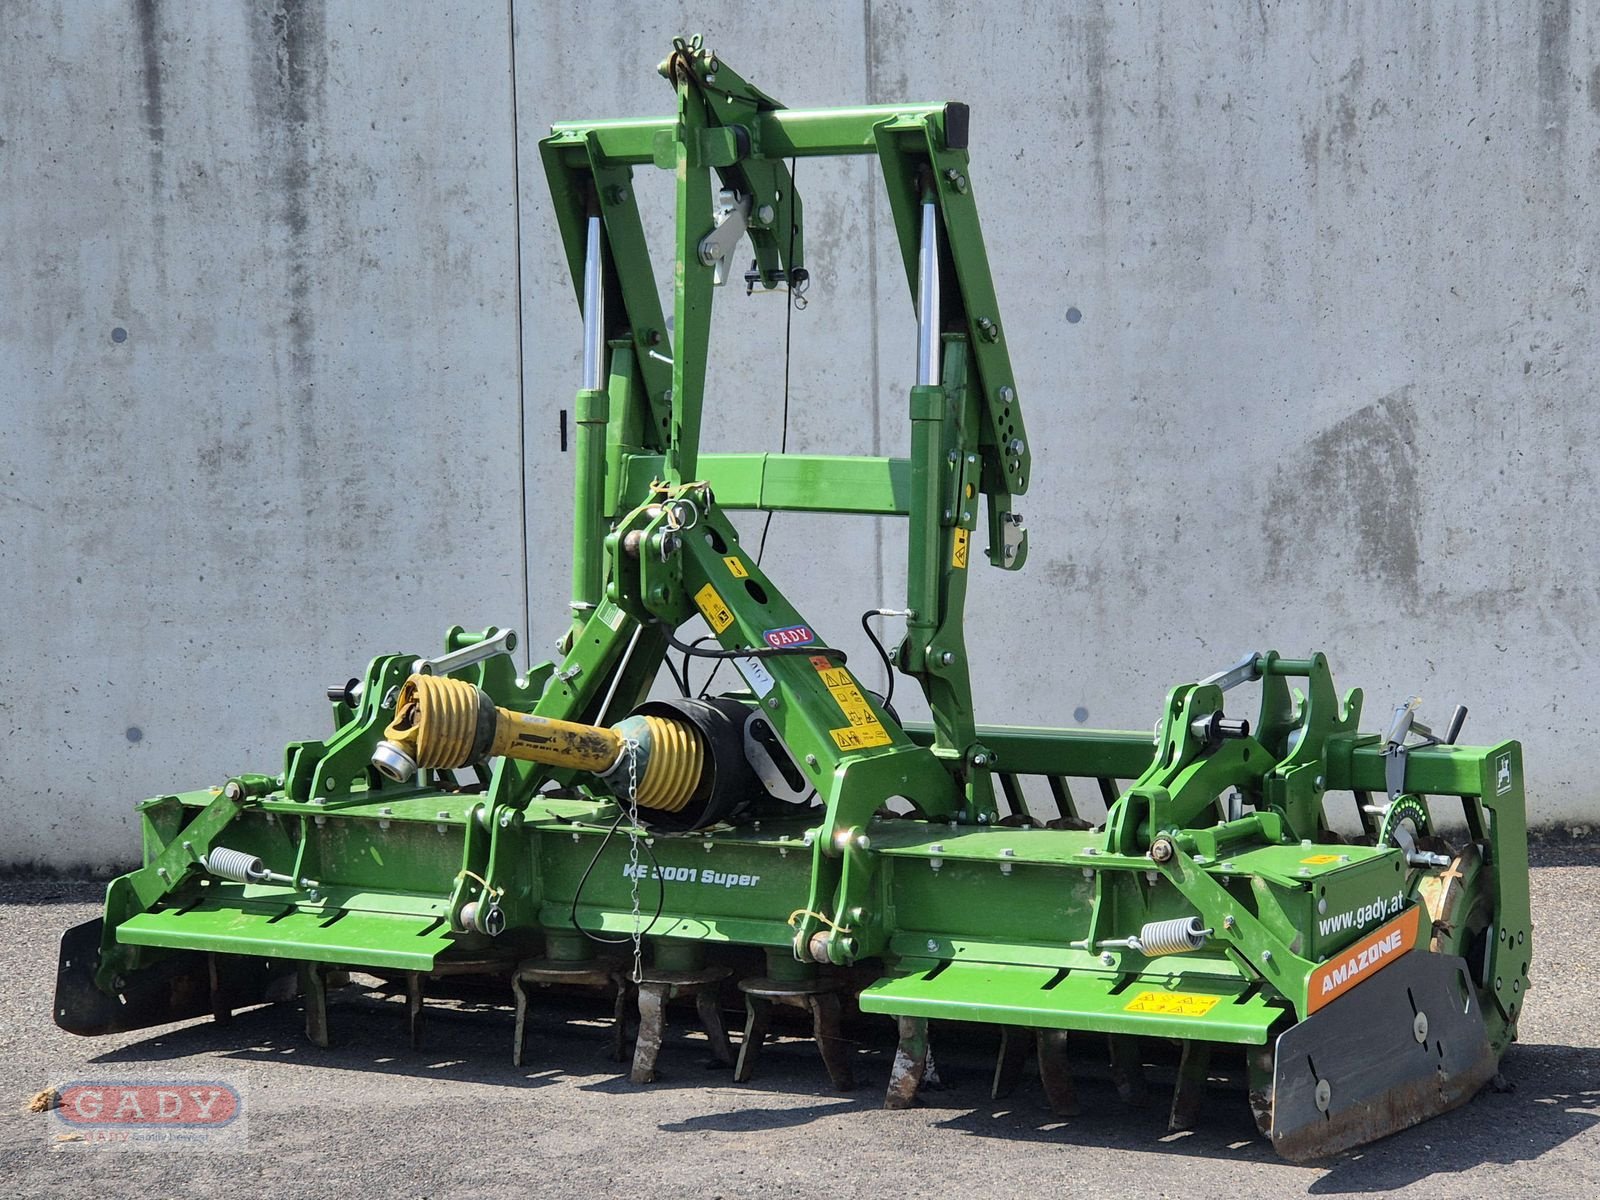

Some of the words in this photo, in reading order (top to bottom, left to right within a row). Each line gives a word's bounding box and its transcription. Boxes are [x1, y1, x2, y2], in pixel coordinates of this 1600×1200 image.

[769, 628, 808, 646] GADY
[623, 863, 648, 877] KE
[651, 866, 697, 882] 3001
[701, 869, 760, 888] Super
[1319, 890, 1403, 937] www.gady.at
[1321, 929, 1402, 996] AMAZONE
